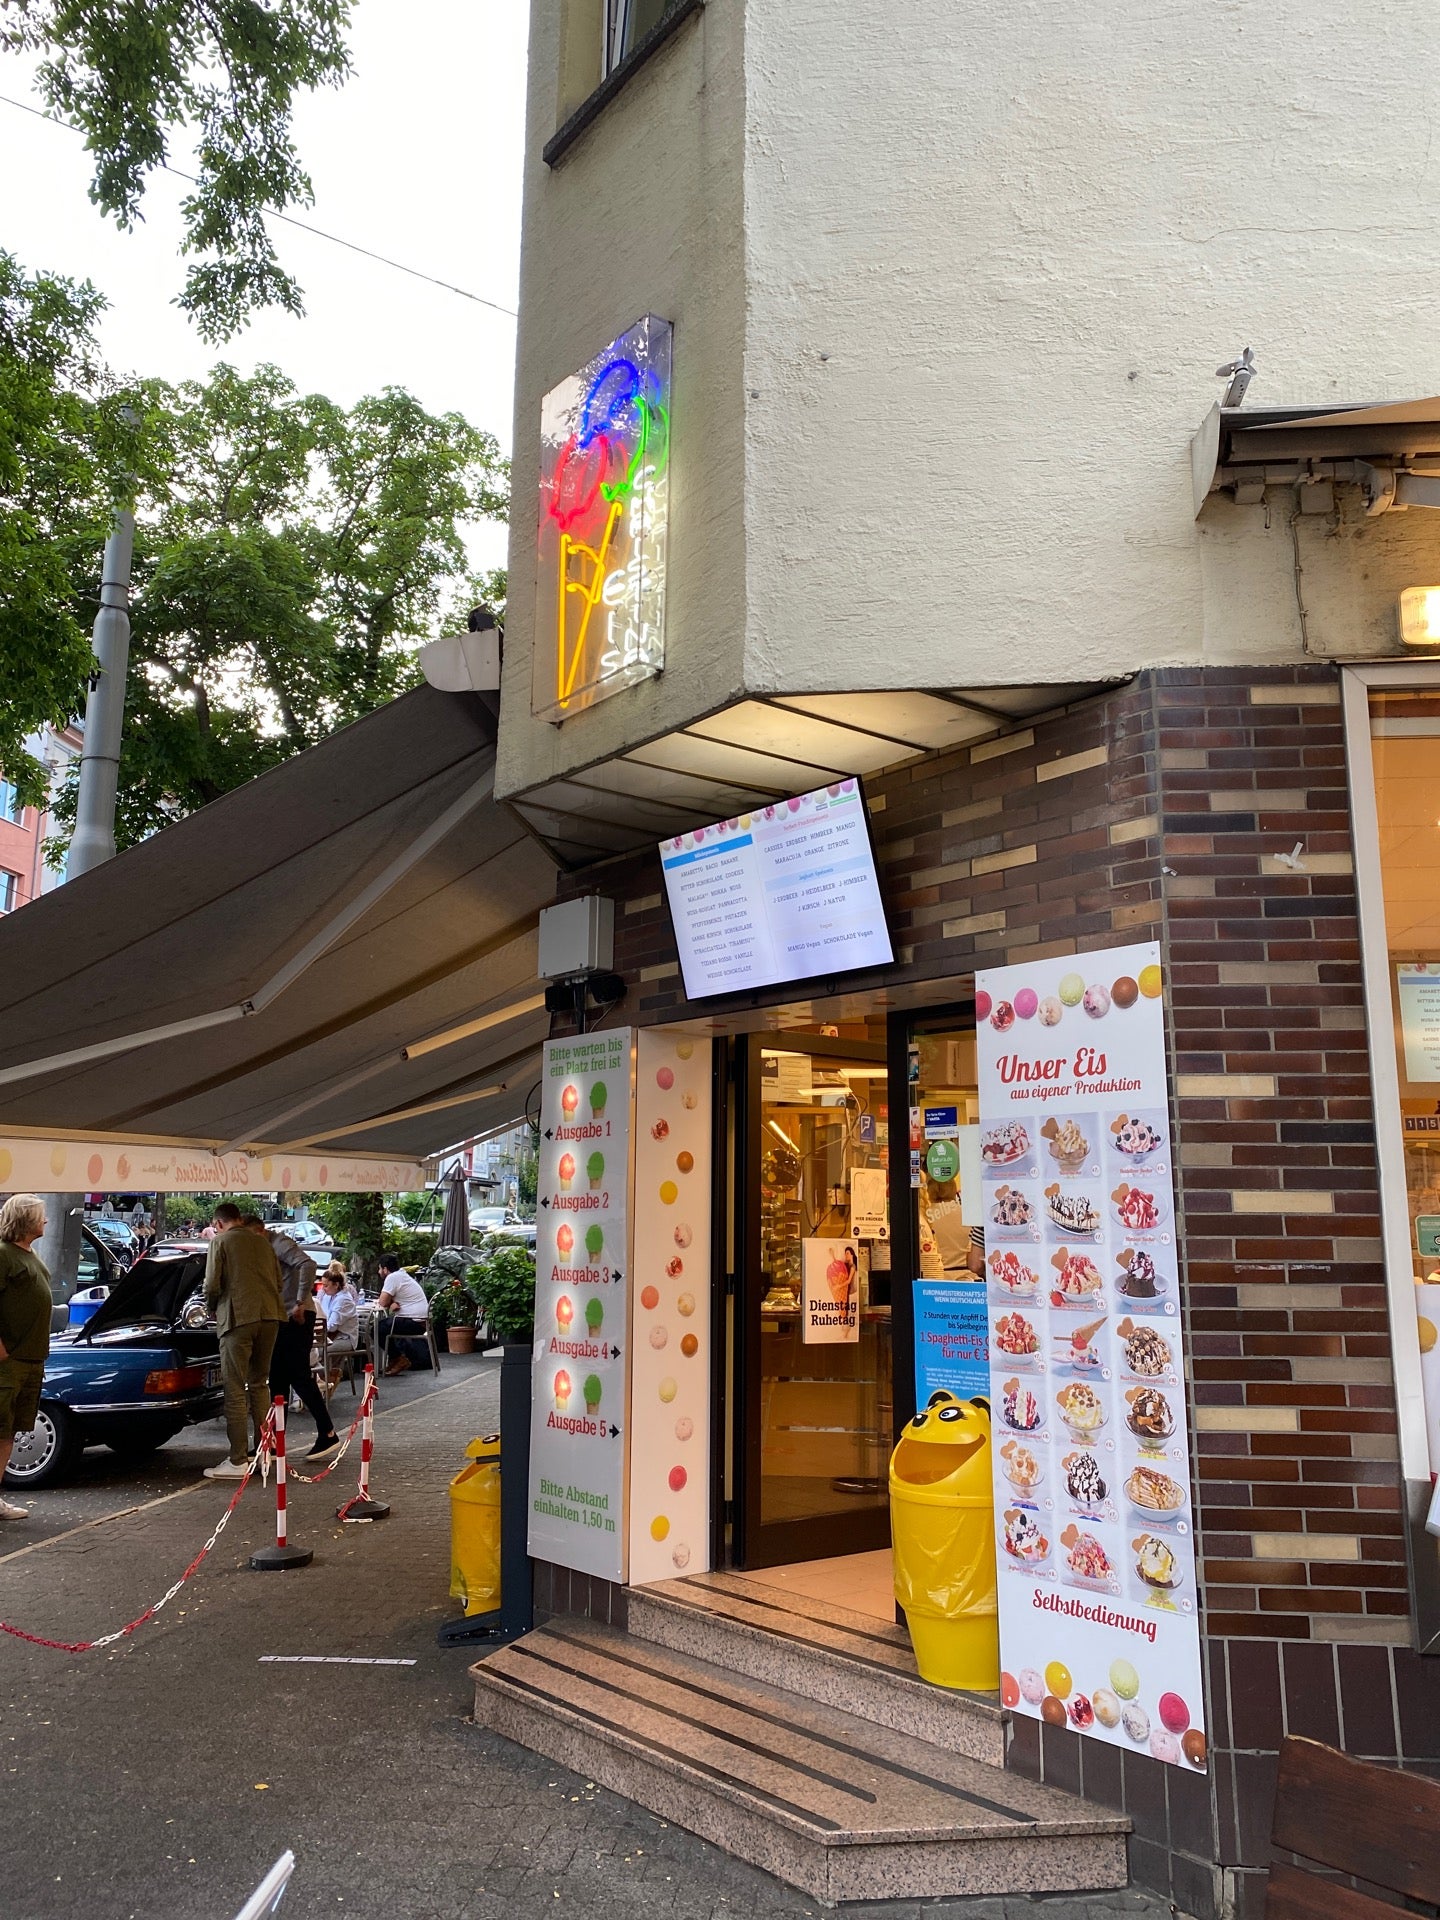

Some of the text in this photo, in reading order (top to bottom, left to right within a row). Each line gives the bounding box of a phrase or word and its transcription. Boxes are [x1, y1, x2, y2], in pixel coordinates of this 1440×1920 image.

[836, 821, 856, 832] MANGO
[823, 932, 856, 945] SCHOKOLADE
[549, 1038, 623, 1062] Bitte warten bis
[550, 1055, 621, 1077] ein Platz frei ist
[996, 1047, 1107, 1084] Unser Eis
[1010, 1077, 1142, 1102] aus eigener Produktion
[555, 1121, 611, 1142] Ausgabe 1
[551, 1192, 609, 1213] Ausgabe 2
[551, 1265, 609, 1285] Ausgabe 3
[809, 1300, 857, 1313] Dienstag
[928, 1312, 951, 1320] Stunden
[961, 1314, 979, 1322] Anpfiff
[811, 1314, 856, 1328] Ruhetag
[550, 1337, 608, 1359] Ausgabe 4
[921, 1332, 983, 1347] 1 Spaghetti-Eis
[942, 1347, 955, 1358] für
[957, 1350, 972, 1359] nur
[974, 1348, 980, 1360] €
[547, 1411, 607, 1438] Ausgabe 5
[540, 1478, 609, 1510] Bitte Abstand
[534, 1499, 616, 1532] einhalten 1,50 m
[1032, 1589, 1158, 1643] Selbstbedienung
